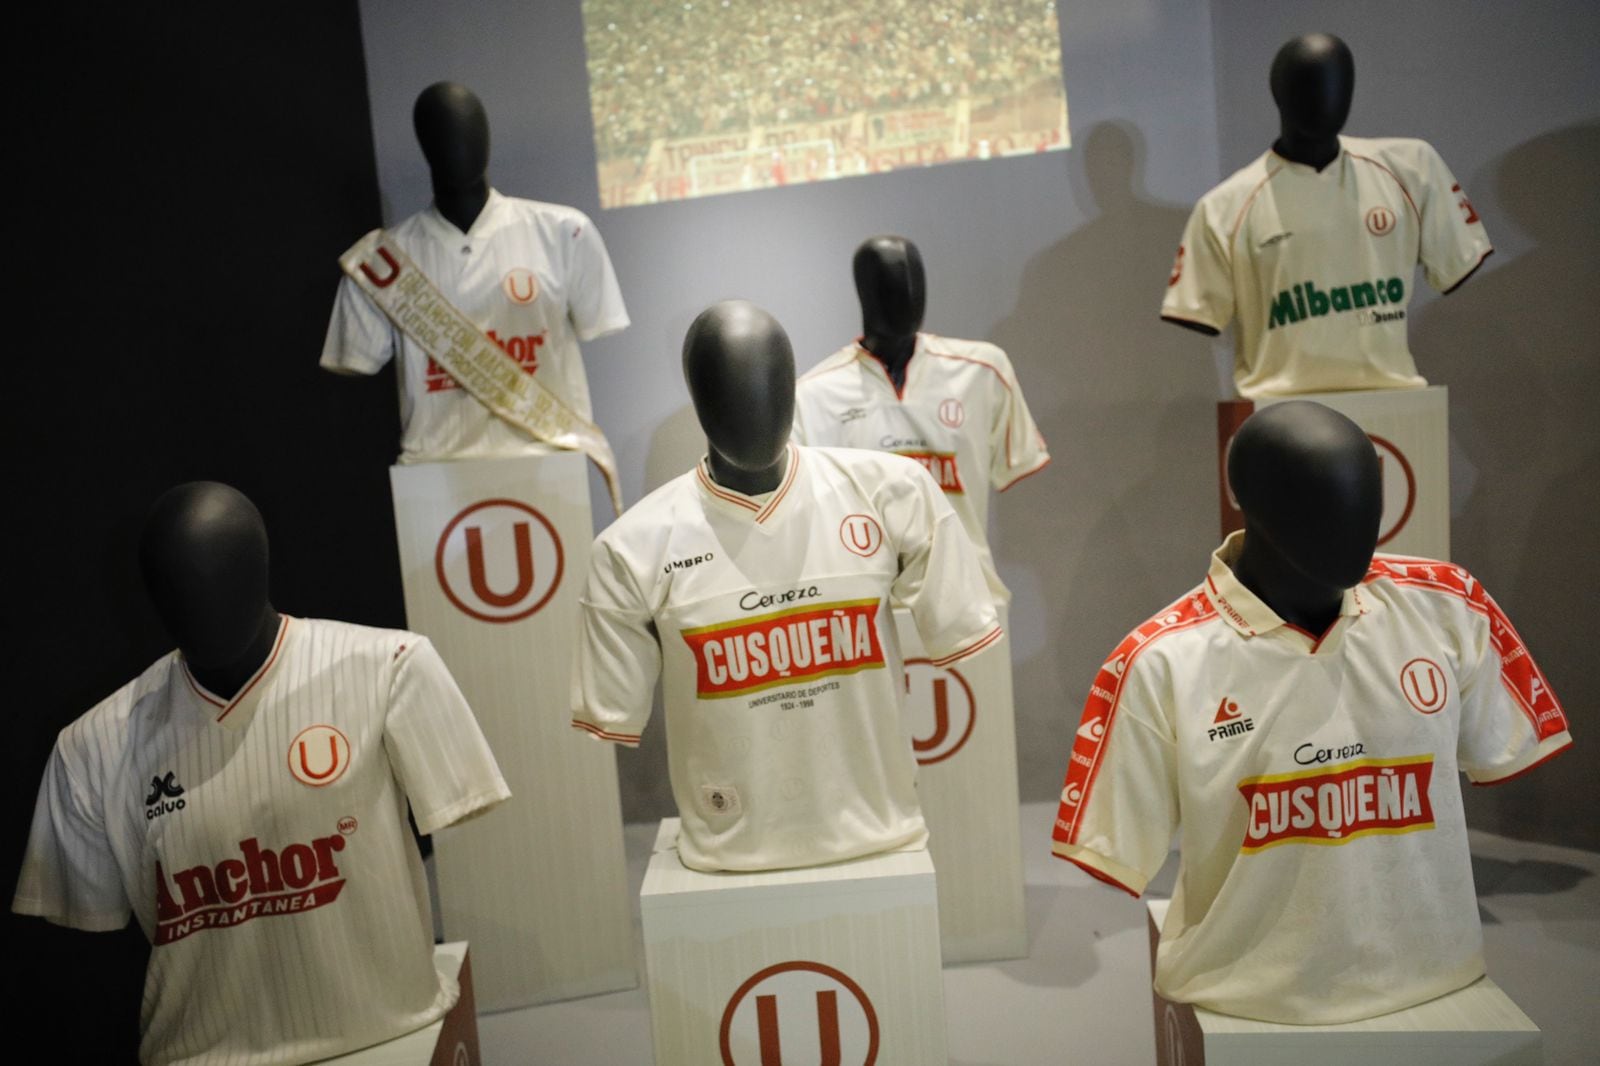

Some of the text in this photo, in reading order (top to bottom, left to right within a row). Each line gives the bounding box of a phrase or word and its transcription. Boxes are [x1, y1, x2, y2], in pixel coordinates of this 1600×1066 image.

[359, 247, 400, 288] U
[1268, 277, 1404, 329] Mibanco
[664, 552, 714, 574] UMBRO
[739, 586, 822, 611] Cerveza
[703, 610, 872, 685] CUSQUEÑA
[748, 689, 797, 709] UNIVERSITARIO
[1294, 743, 1368, 765] Cerveza
[146, 798, 186, 820] calvo
[1249, 768, 1422, 840] CUSQUEÑA
[156, 833, 346, 921] Anchor
[168, 892, 316, 940] INSTANTANEA
[755, 990, 841, 1066] U
